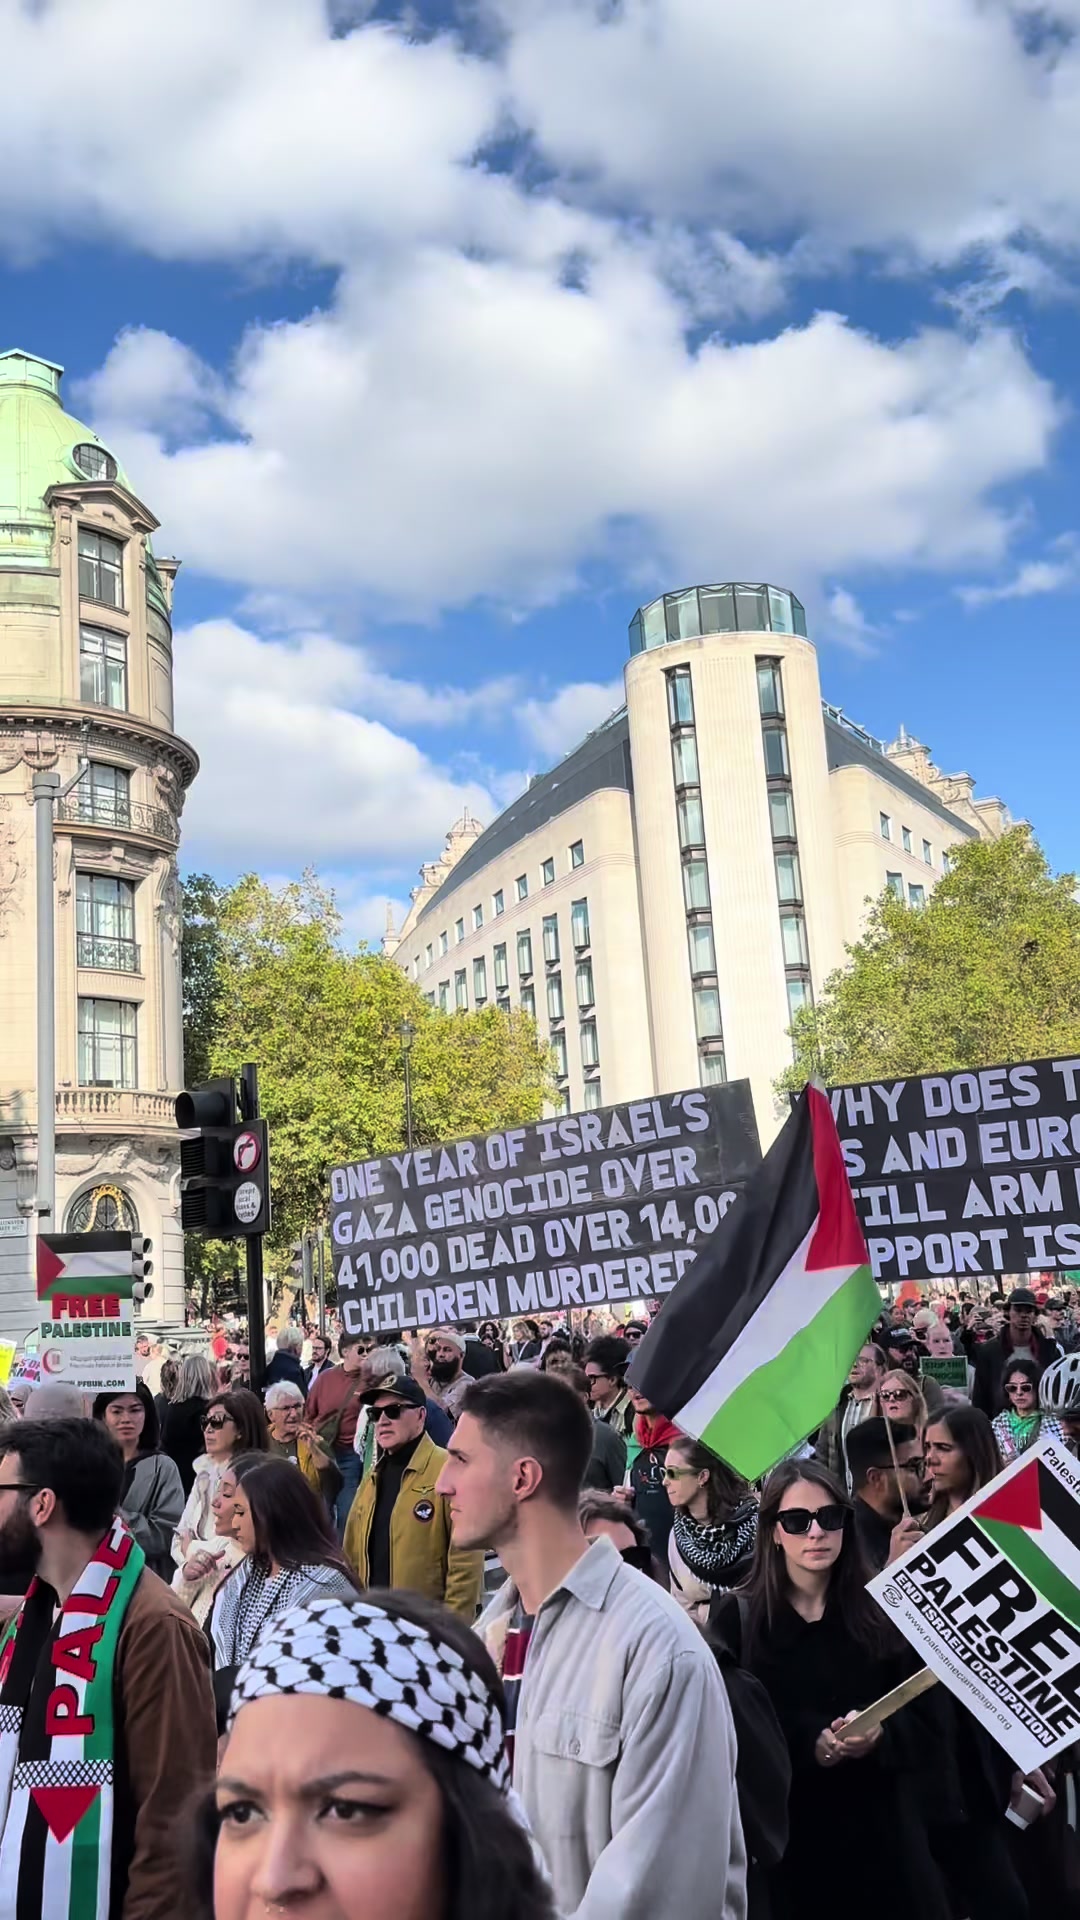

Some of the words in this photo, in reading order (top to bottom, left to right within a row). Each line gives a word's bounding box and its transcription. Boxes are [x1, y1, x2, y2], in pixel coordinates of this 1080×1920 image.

[921, 1065, 1041, 1118] DOES
[331, 1160, 385, 1203] ONE
[388, 1142, 478, 1190] YEAR
[486, 1129, 526, 1172] OF
[536, 1093, 711, 1164] ISRAEL'S
[881, 1127, 968, 1175] AND
[332, 1201, 418, 1246] GAZA
[424, 1163, 593, 1230] GENOCIDE
[600, 1146, 700, 1198] OVER
[961, 1170, 1064, 1219] ARM
[337, 1246, 440, 1292] 41,000
[448, 1225, 536, 1274] DEAD
[544, 1208, 633, 1259] OVER
[864, 1228, 1009, 1279] PPORT
[41, 1321, 131, 1339] PALESTINE
[52, 1293, 121, 1320] FREE
[342, 1278, 501, 1336] CHILDREN
[895, 1573, 924, 1604] END
[921, 1604, 973, 1662] ISRAELI
[970, 1660, 1055, 1745] OCCUPATION
[904, 1552, 1080, 1737] PALESTINE
